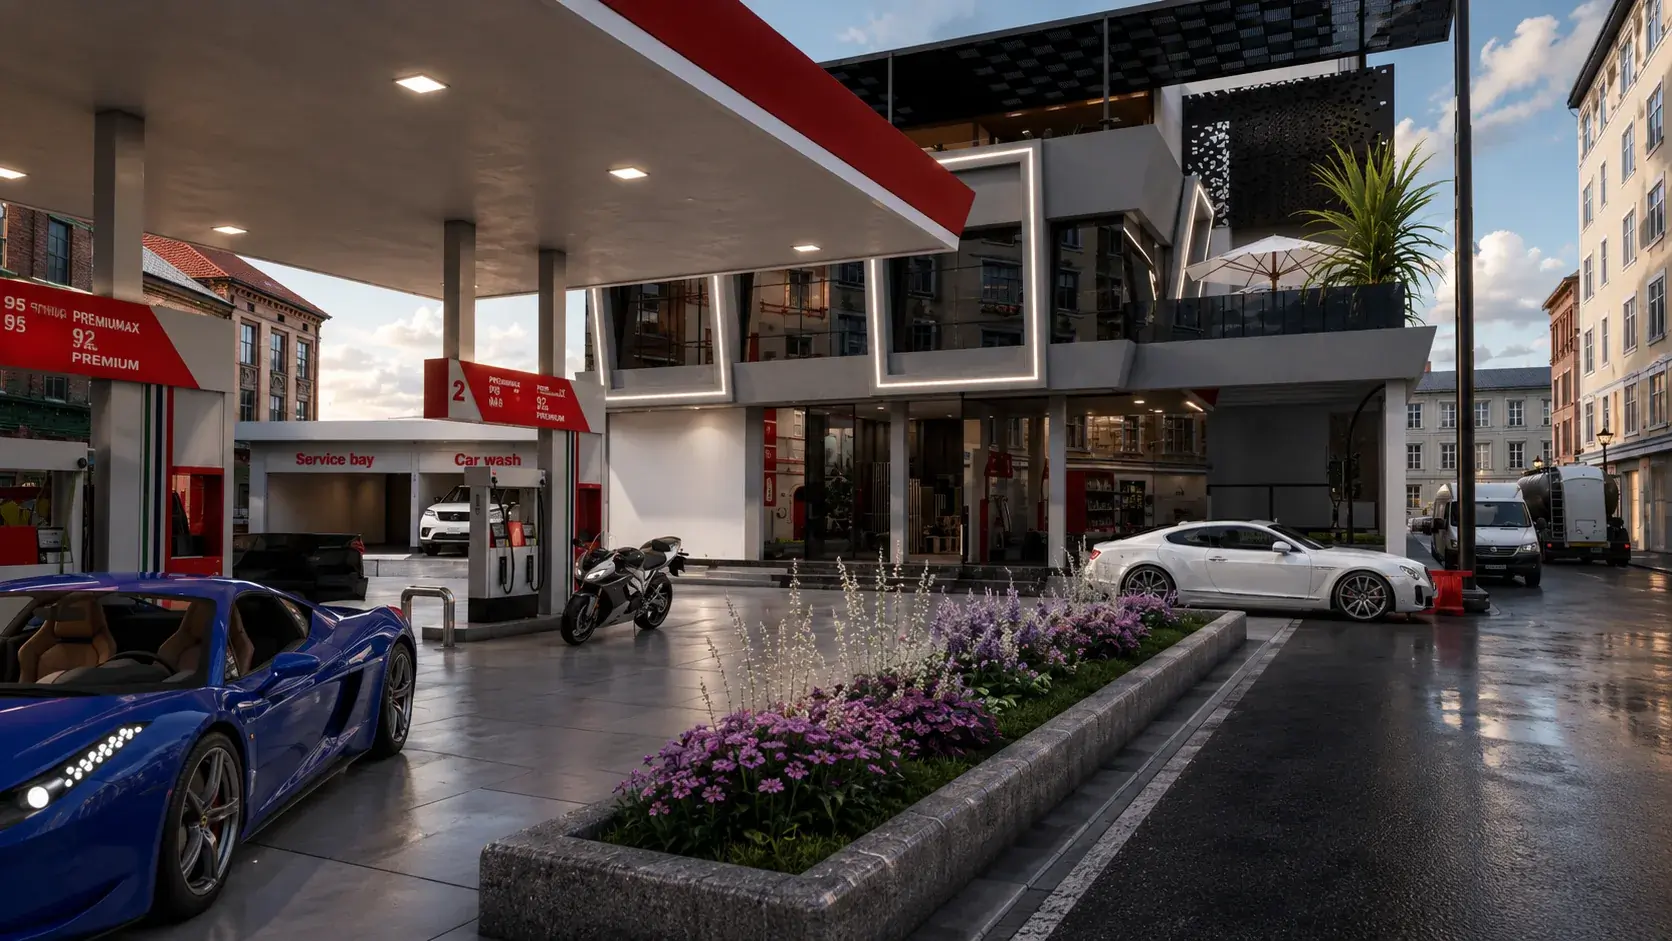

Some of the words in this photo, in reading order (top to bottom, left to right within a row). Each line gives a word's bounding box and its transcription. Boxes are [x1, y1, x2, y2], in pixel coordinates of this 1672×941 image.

[4, 295, 26, 312] 95
[72, 309, 140, 335] PREMIUMAX
[72, 351, 140, 371] PREMIUM
[452, 380, 466, 402] 2
[296, 452, 346, 466] Service
[349, 452, 375, 468] bay
[454, 452, 480, 466] Car
[484, 452, 522, 466] wash
